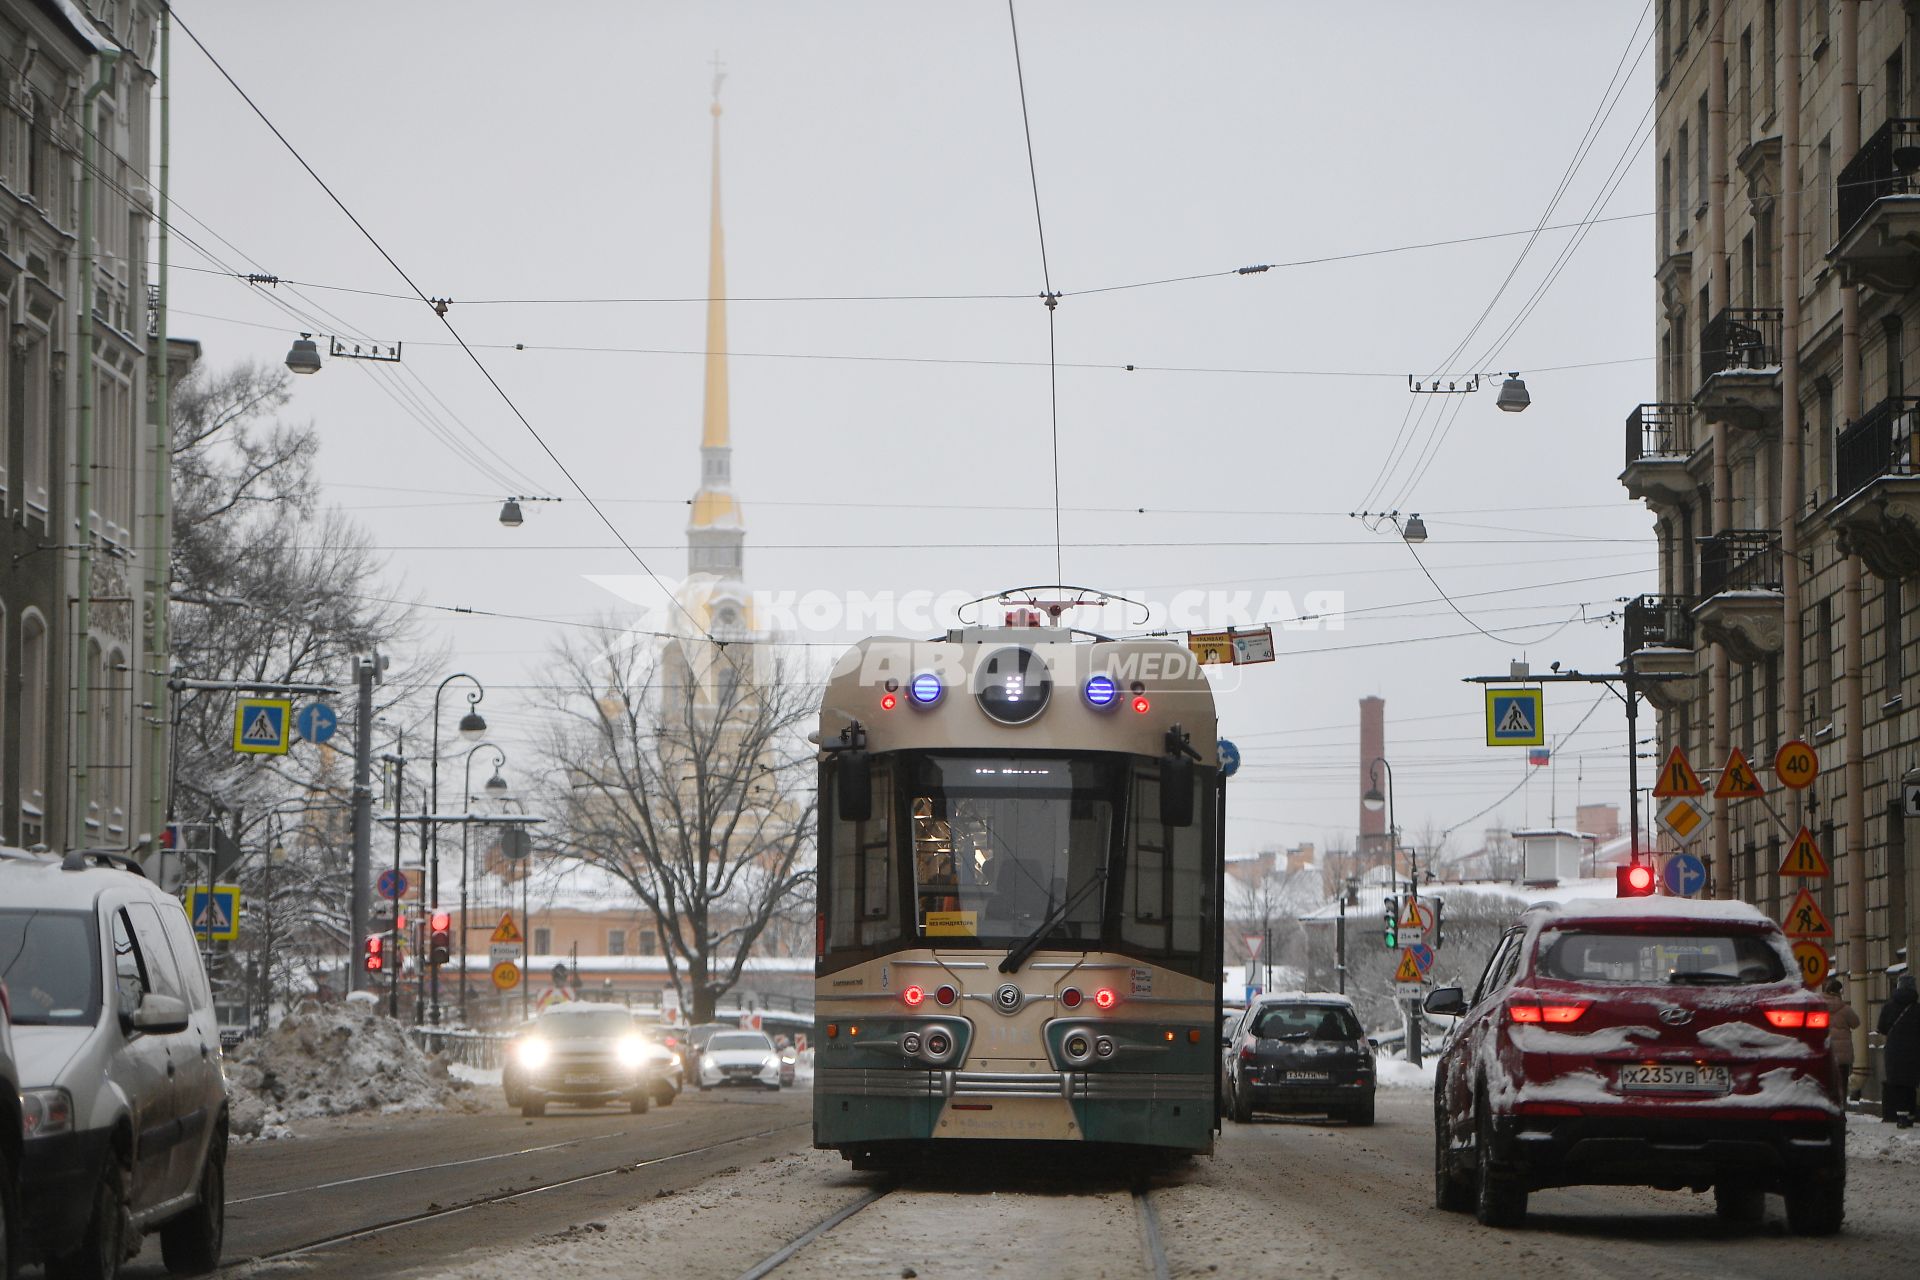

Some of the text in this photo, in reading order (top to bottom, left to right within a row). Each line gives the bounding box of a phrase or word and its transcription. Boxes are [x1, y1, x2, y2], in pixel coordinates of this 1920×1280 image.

[1204, 648, 1218, 661] 10
[1786, 755, 1810, 773] 40
[498, 970, 515, 981] 40
[1629, 1067, 1695, 1084] Х235УВ
